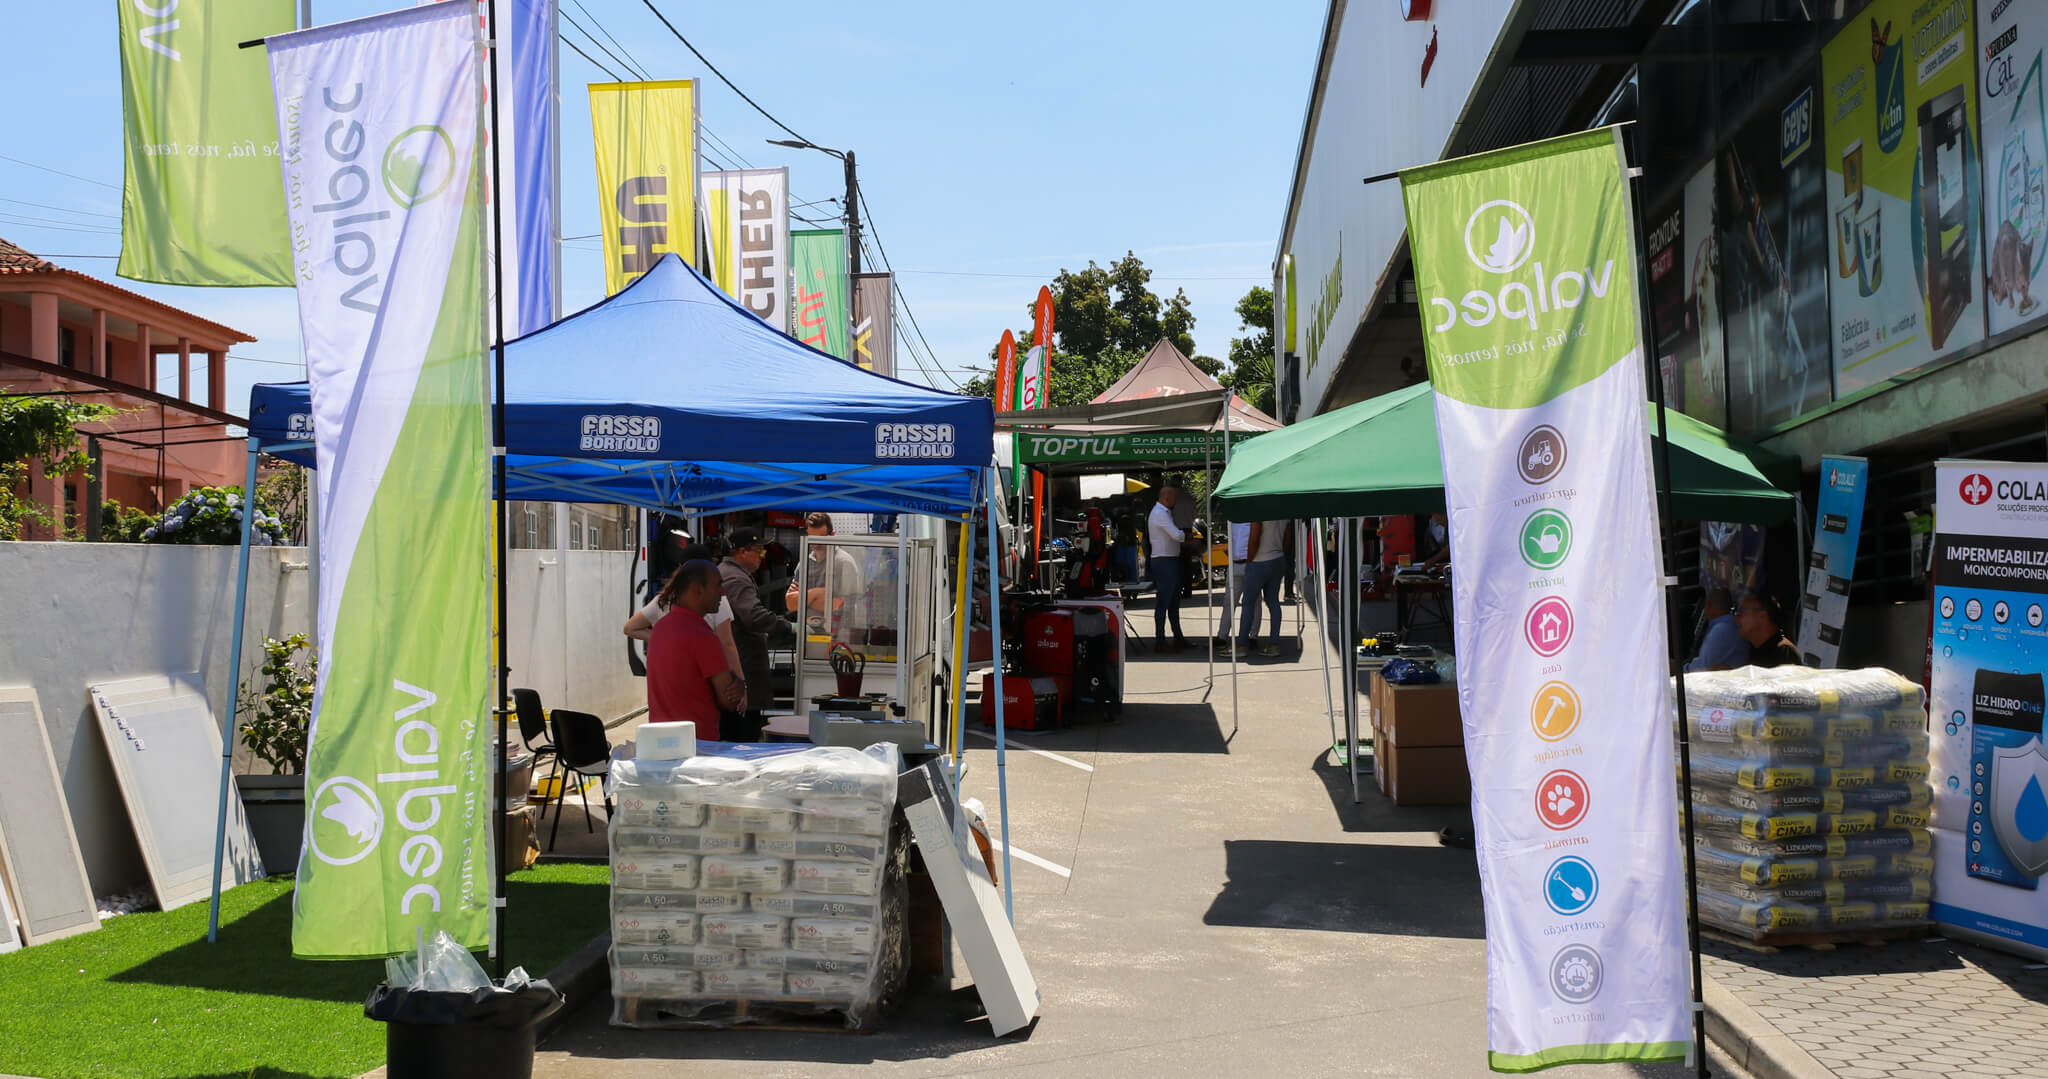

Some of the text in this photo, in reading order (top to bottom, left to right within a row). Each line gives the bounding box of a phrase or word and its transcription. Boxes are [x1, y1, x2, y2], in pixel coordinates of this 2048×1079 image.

[1986, 54, 2014, 98] Cat
[580, 415, 661, 438] FASSA
[876, 423, 954, 444] FASSA
[580, 435, 660, 452] BORTOLO
[1031, 437, 1120, 457] TOPTUL
[1132, 436, 1226, 445] Professiona
[876, 441, 954, 458] BORTOLO
[1997, 480, 2048, 502] COLA
[1975, 694, 1989, 707] LIZ
[1990, 696, 2020, 710] HIDRO
[1838, 823, 1874, 834] CINZA
[1893, 815, 1927, 826] CINZA
[1776, 826, 1812, 837] CINZA
[834, 843, 847, 854] 50
